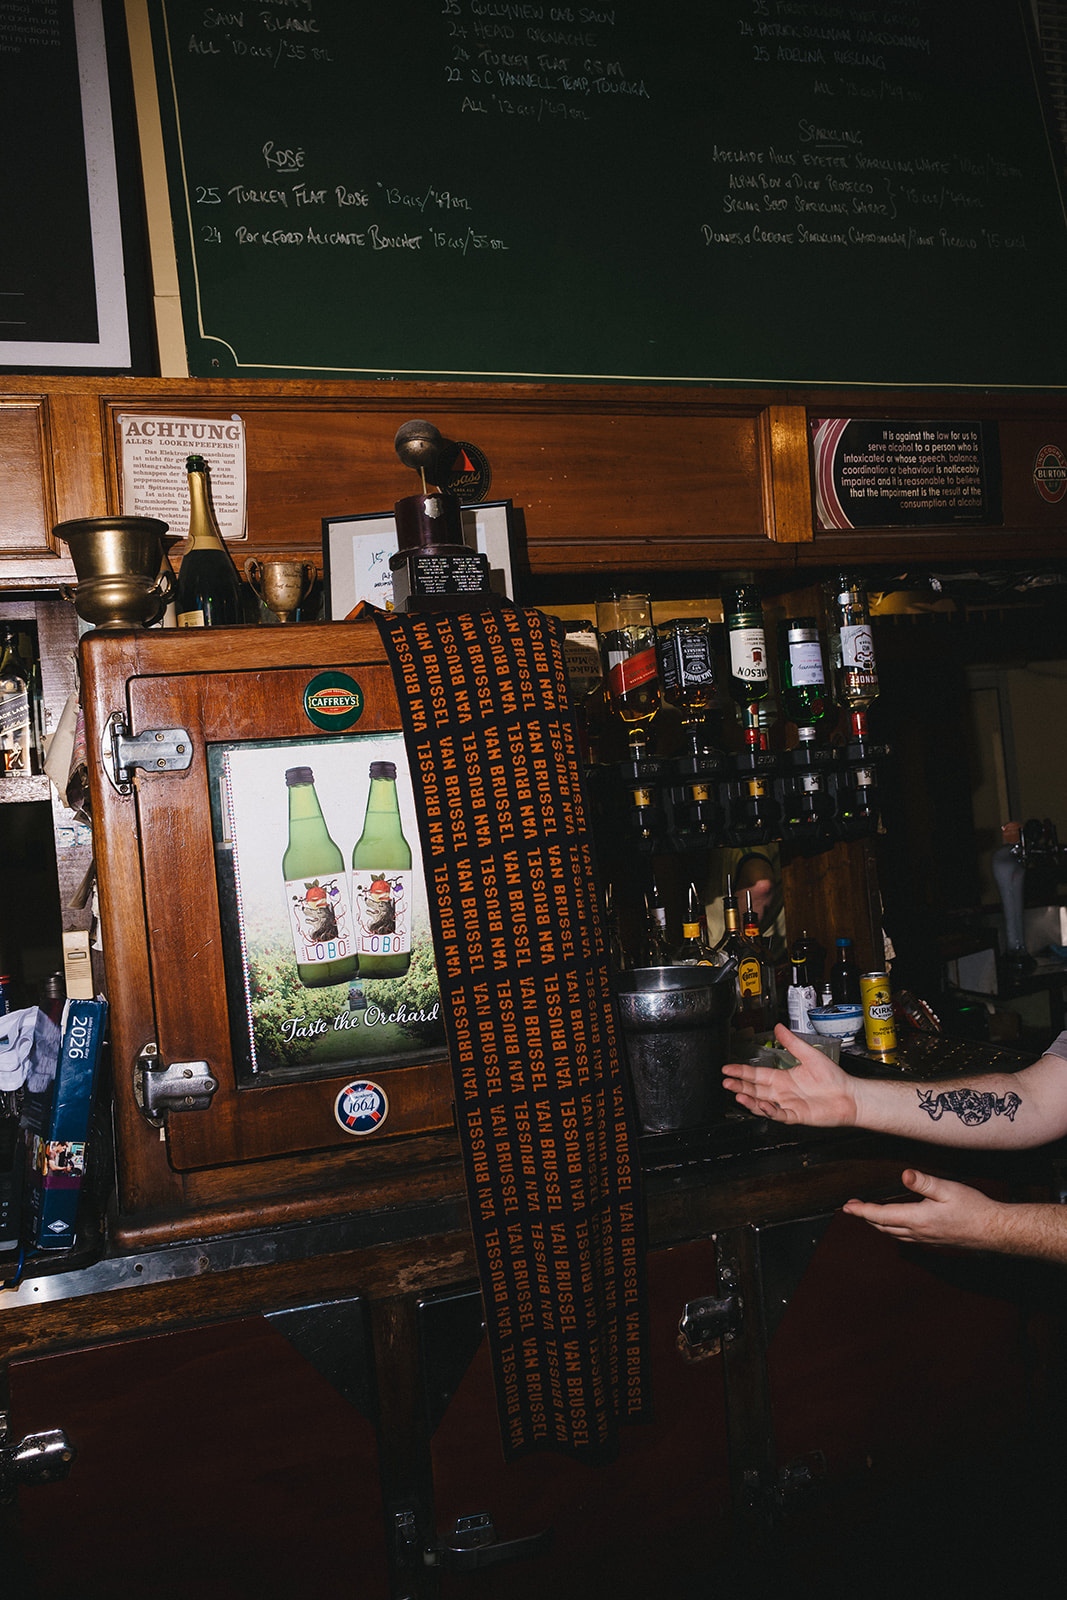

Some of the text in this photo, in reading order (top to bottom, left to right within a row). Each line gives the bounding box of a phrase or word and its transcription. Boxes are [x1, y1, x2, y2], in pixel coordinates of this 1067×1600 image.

[196, 186, 222, 204] 25
[228, 185, 288, 208] TURKEY
[292, 183, 328, 207] FLAT
[201, 226, 222, 244] 24
[126, 421, 240, 440] ACHTUNG
[883, 430, 888, 440] It
[889, 430, 894, 440] is
[895, 431, 921, 442] against
[922, 431, 935, 440] the
[936, 431, 950, 440] law
[950, 430, 960, 440] for
[970, 431, 978, 440] to
[868, 443, 887, 451] serve
[888, 442, 914, 451] alcohol
[915, 442, 923, 451] to
[931, 444, 956, 454] person
[957, 442, 972, 451] who
[973, 442, 978, 451] is
[842, 465, 888, 475] coordination
[898, 465, 935, 474] behaviour
[936, 464, 942, 474] is
[943, 464, 980, 475] noticeably
[1038, 469, 1066, 478] BURTON
[841, 475, 981, 488] impaired and it is reasonable to believe
[850, 486, 982, 499] that the impairment is the result of the
[436, 618, 472, 725] VAN BRUSSEL
[480, 611, 517, 715] VAN BRUSSEL
[567, 657, 588, 665] Mar
[570, 666, 599, 674] Make
[737, 667, 767, 678] MESON
[391, 626, 427, 733] VAN BRUSSEL
[851, 675, 877, 685] RNOFF
[311, 697, 356, 707] CAFFREY'S
[0, 711, 12, 720] ACK
[439, 735, 467, 852] VAN BRUSSEL
[484, 725, 514, 843] VAN BRUSSEL
[457, 857, 484, 974] VAN BRUSSEL
[480, 854, 507, 971] VAN BRUSSEL
[503, 849, 531, 968] VAN BRUSSEL
[434, 863, 461, 979] VAN BRUSSEL
[305, 940, 347, 962] LOBO
[362, 936, 401, 953] LOBO
[281, 1003, 440, 1043] Taste the Orchard
[520, 976, 546, 1092] VAN BRUSSEL
[68, 1016, 88, 1059] 2026
[473, 982, 502, 1097] VAN BRUSSEL
[349, 1098, 375, 1113] 1664
[536, 1099, 561, 1212] VAN BRUSSEL
[507, 1222, 534, 1329] VAN BRUSSEL
[550, 1222, 576, 1333] VAN BRUSSEL
